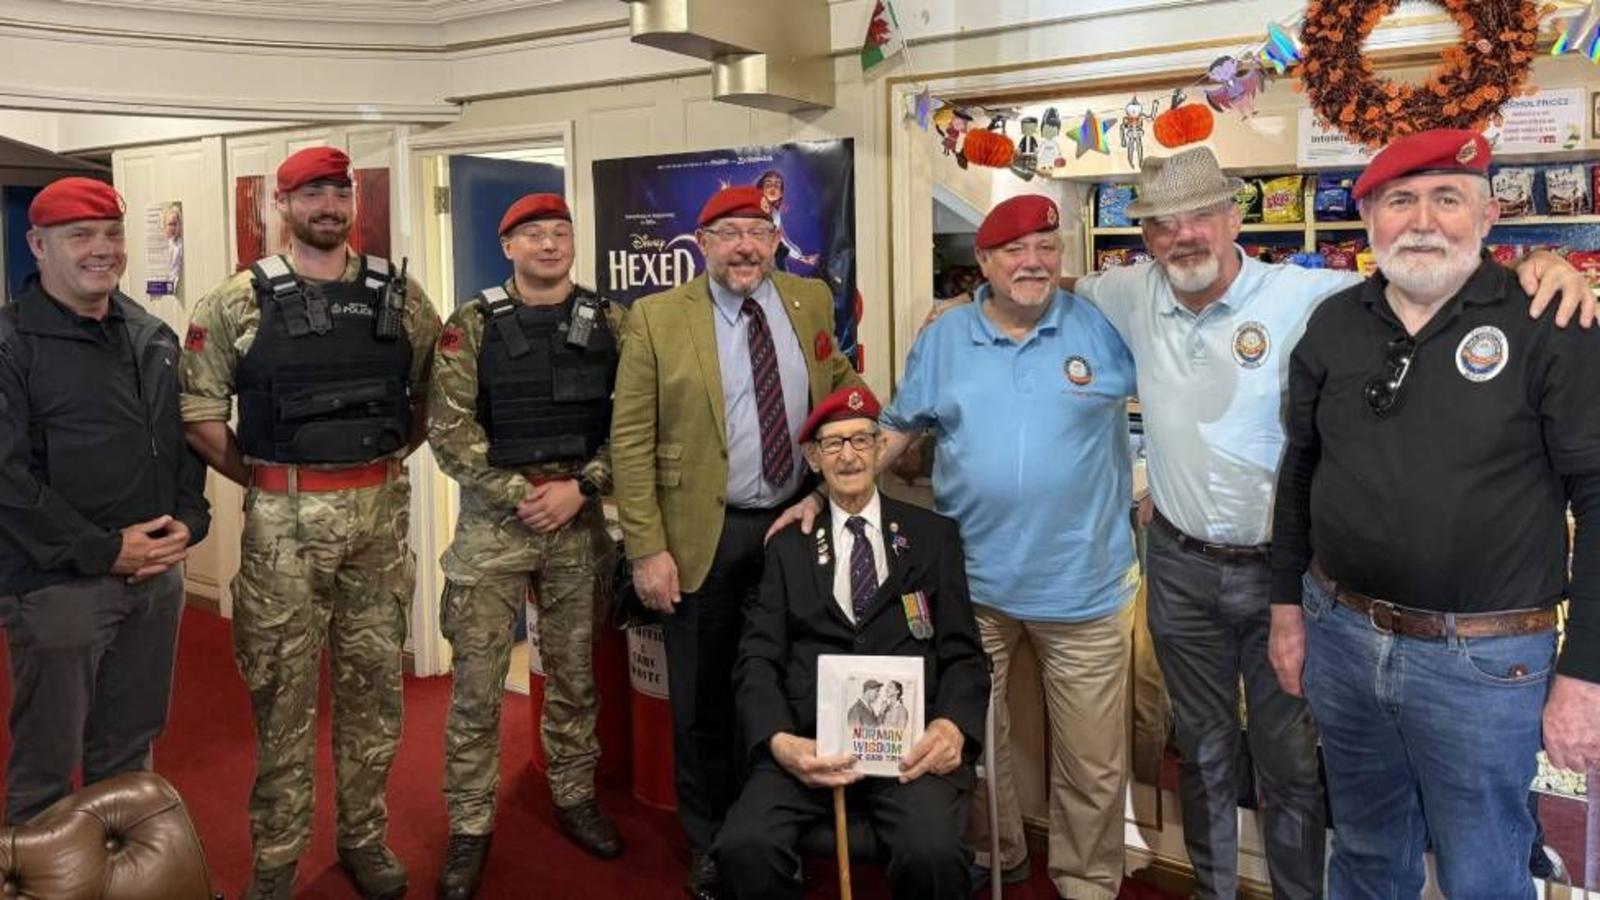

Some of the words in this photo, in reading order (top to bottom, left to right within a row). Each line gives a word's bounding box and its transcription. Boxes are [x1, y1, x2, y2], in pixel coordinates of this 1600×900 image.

[629, 233, 666, 251] Disney
[608, 248, 695, 290] HEXED
[343, 305, 373, 316] POLICE
[852, 728, 903, 741] NORMAN
[853, 741, 903, 754] WISDOM
